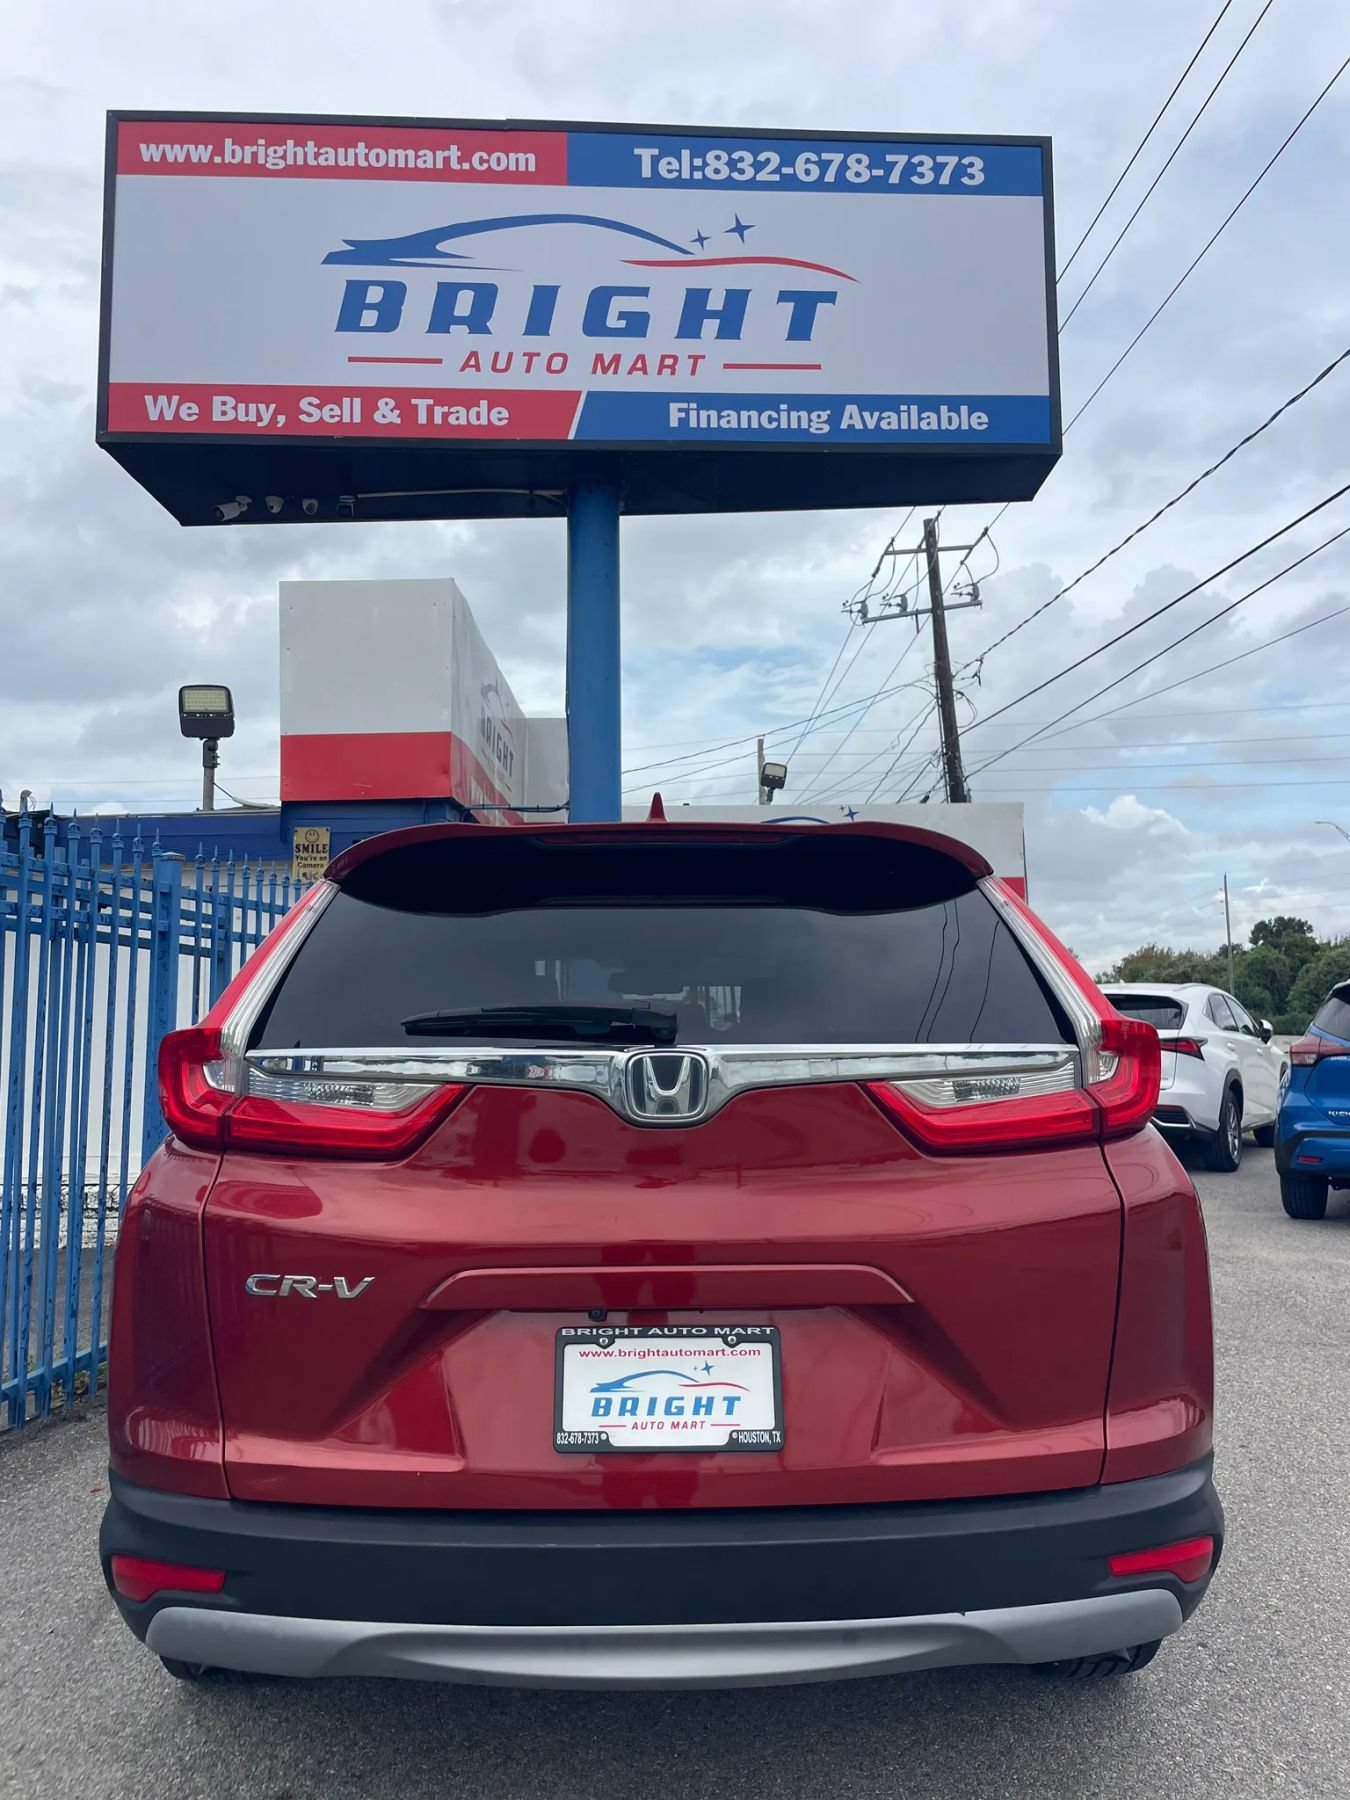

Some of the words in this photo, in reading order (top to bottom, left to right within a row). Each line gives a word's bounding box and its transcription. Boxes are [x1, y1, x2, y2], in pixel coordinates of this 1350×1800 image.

[139, 138, 537, 173] www.brightautomart.com
[633, 147, 986, 187] Tel:832-678-7373
[334, 278, 838, 342] BRIGHT
[458, 350, 569, 375] AUTO
[590, 352, 706, 377] MART
[144, 394, 200, 422] We
[211, 395, 287, 428] Buy,
[298, 396, 362, 425] Sell
[376, 398, 402, 424] &
[411, 397, 510, 426] Trade
[668, 402, 831, 434] Financing
[839, 403, 990, 431] Available
[295, 844, 328, 854] SMILE
[245, 1273, 376, 1299] CR-V
[561, 1327, 643, 1336] BRIGHT
[647, 1327, 707, 1336] AUTO
[713, 1326, 776, 1335] MART
[578, 1348, 761, 1360] www.brightautomart.com
[590, 1396, 742, 1417] BRIGHT
[631, 1421, 665, 1430] AUTO
[670, 1420, 707, 1430] MART
[556, 1432, 599, 1445] 832-678-7373
[738, 1431, 772, 1445] HOUSTON,
[772, 1431, 781, 1444] TX
